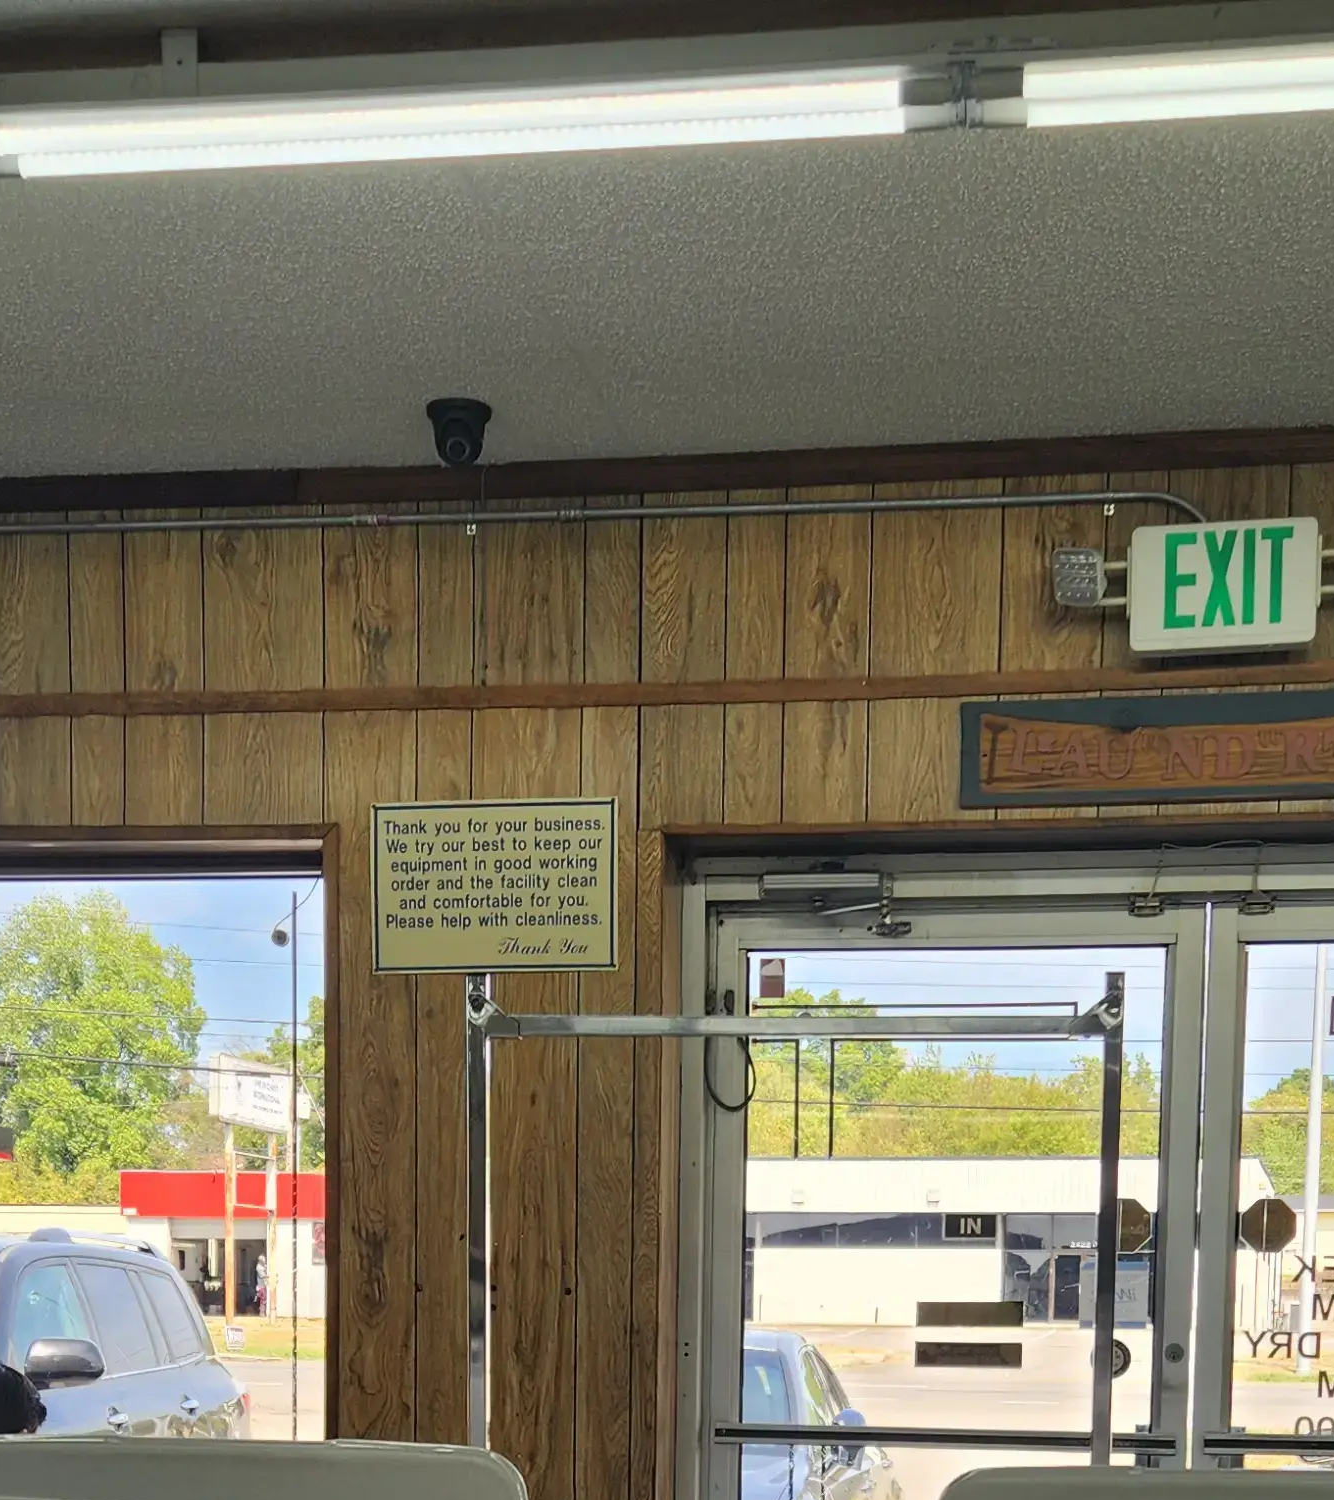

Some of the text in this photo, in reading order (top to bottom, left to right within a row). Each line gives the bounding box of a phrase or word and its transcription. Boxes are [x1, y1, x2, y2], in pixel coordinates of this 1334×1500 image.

[1162, 525, 1294, 631] EXIT
[384, 816, 605, 837] Thank you for your business.
[386, 836, 602, 856] We try our best to keep our
[390, 855, 597, 875] equipment in good working
[391, 873, 597, 892] order and the facility clean
[399, 893, 589, 910] and comfortable for you.
[385, 911, 603, 930] Please help with cleanliness.
[497, 937, 589, 956] Thank You
[959, 1217, 982, 1235] IN
